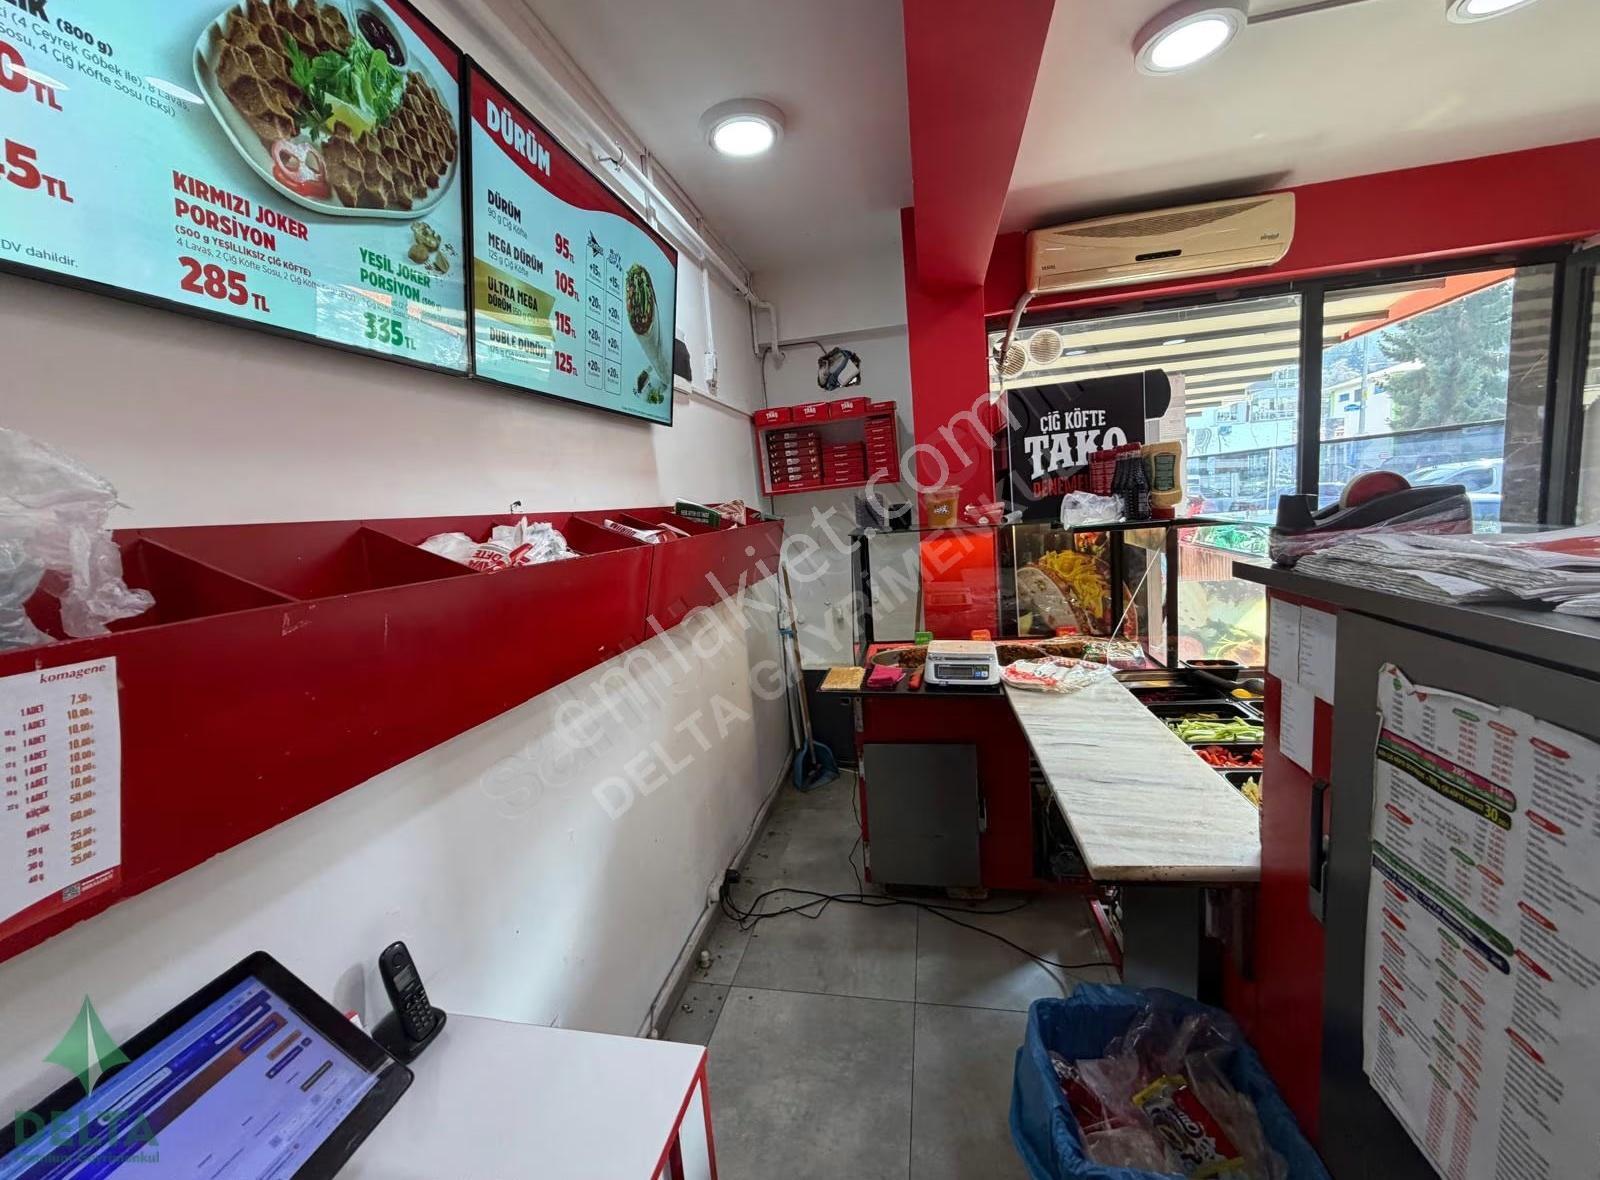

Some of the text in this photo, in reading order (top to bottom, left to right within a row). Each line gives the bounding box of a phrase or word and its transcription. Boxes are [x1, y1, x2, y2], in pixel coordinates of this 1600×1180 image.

[12, 13, 27, 28] (4
[32, 23, 78, 54] Çeyrek
[82, 49, 123, 78] Göbek
[57, 18, 94, 46] (800
[97, 41, 113, 57] g)
[40, 44, 48, 54] 4
[53, 49, 74, 71] Çiğ
[78, 61, 112, 86] Köfte
[114, 80, 143, 101] Sosu
[145, 95, 176, 118] (Ekşi)
[486, 98, 550, 177] DÜRÜM
[172, 170, 309, 242] KIRMIZI JOKER
[174, 196, 277, 252] PORSİYON
[487, 188, 521, 224] DÜRÜM
[26, 244, 80, 269] dahildir.
[175, 224, 312, 279] (500 g YEŞİLLİKSİZ ÇİĞ KÖFTE)
[177, 237, 184, 247] 4
[185, 239, 214, 258] Lavaş,
[215, 250, 222, 259] 2
[223, 252, 238, 265] Çiğ
[238, 256, 261, 271] Köfte
[359, 246, 431, 288] YEŞİL JOKER
[488, 231, 544, 275] MEGA DÜRÜM
[177, 255, 271, 312] 285 TL
[359, 267, 420, 303] PORSİYON
[488, 275, 538, 312] ULTRA MEGA
[488, 293, 512, 314] DÜRÜM
[363, 311, 405, 346] 335
[405, 336, 417, 351] TL
[1039, 407, 1107, 435] ÇİĞ KÖFTE
[1023, 426, 1128, 481] TAKO
[40, 665, 107, 684] komagene
